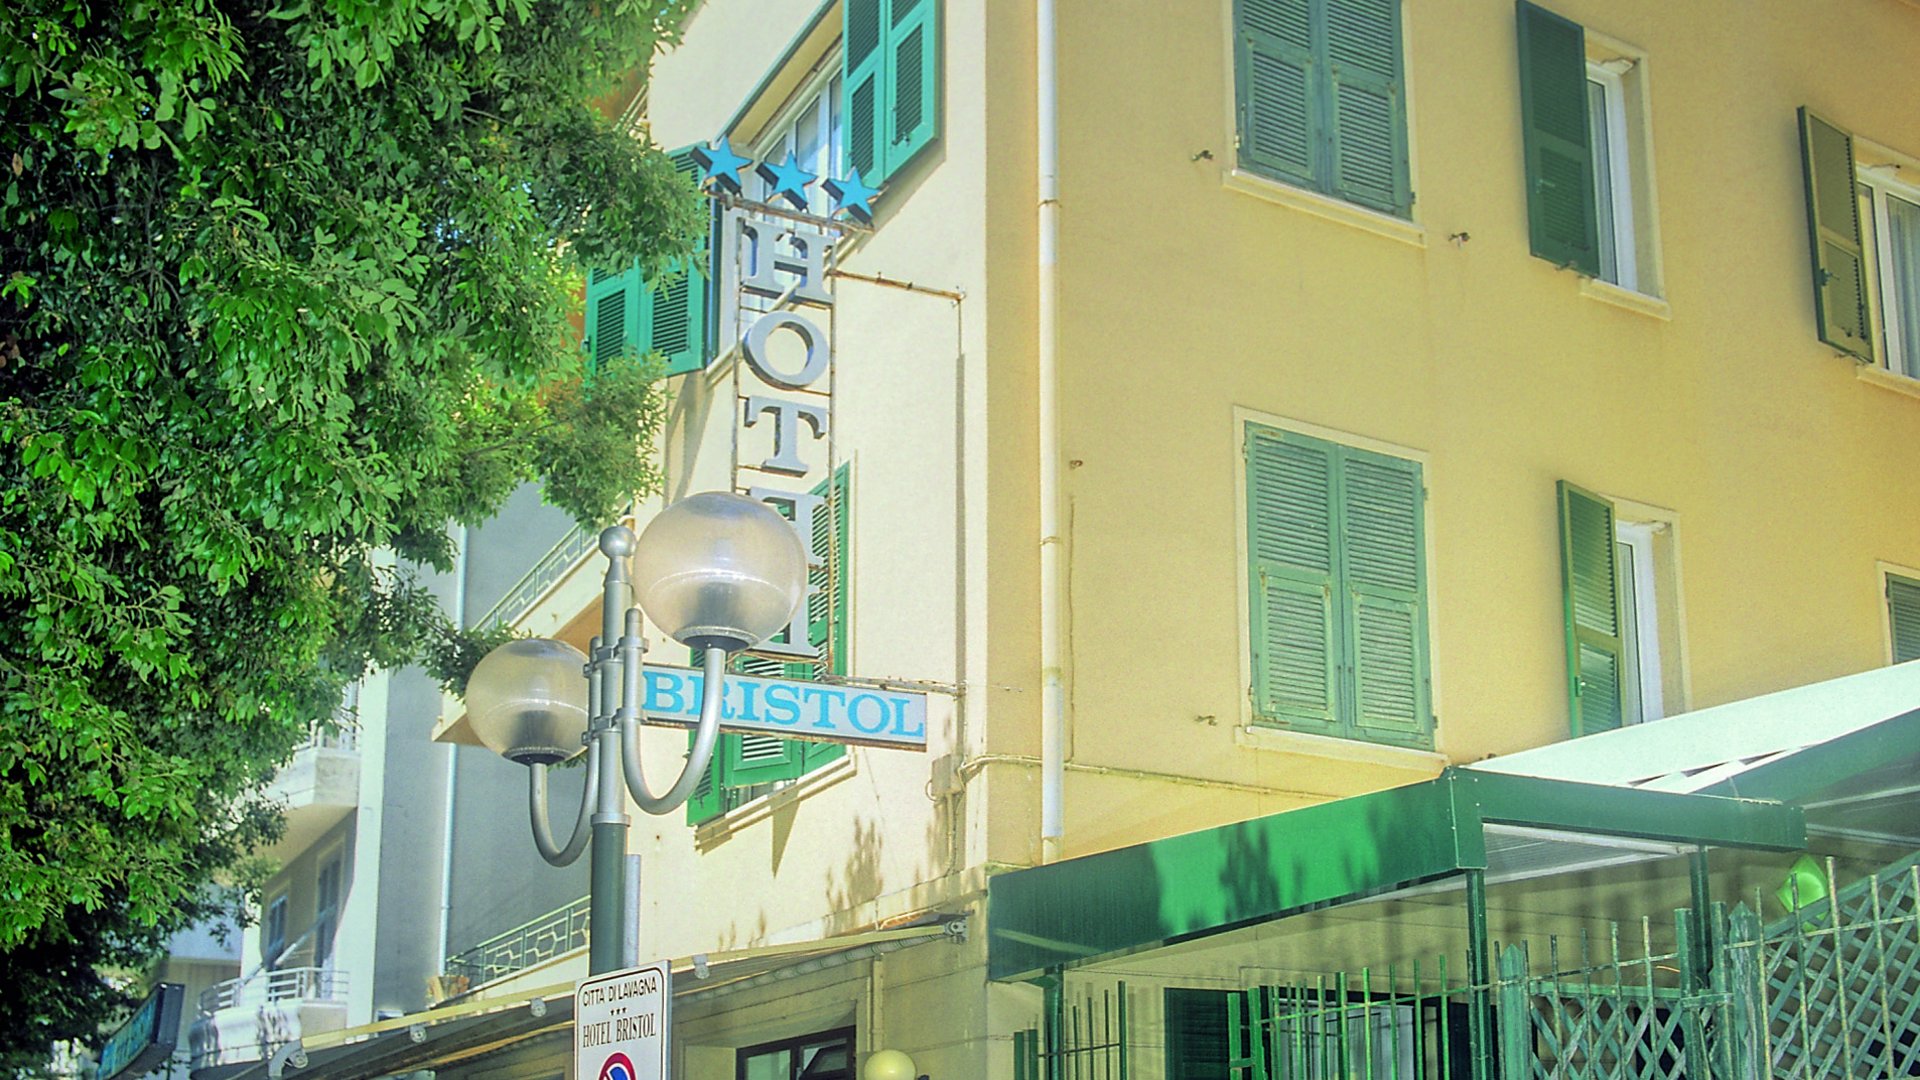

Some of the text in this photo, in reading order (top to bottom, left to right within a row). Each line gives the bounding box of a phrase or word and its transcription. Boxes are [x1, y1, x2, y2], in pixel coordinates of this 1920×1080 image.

[641, 671, 924, 737] BRISTOL
[608, 986, 616, 1002] DI
[618, 977, 657, 1000] LAVAGNA
[583, 1013, 656, 1048] HOTEL BRISTOL
